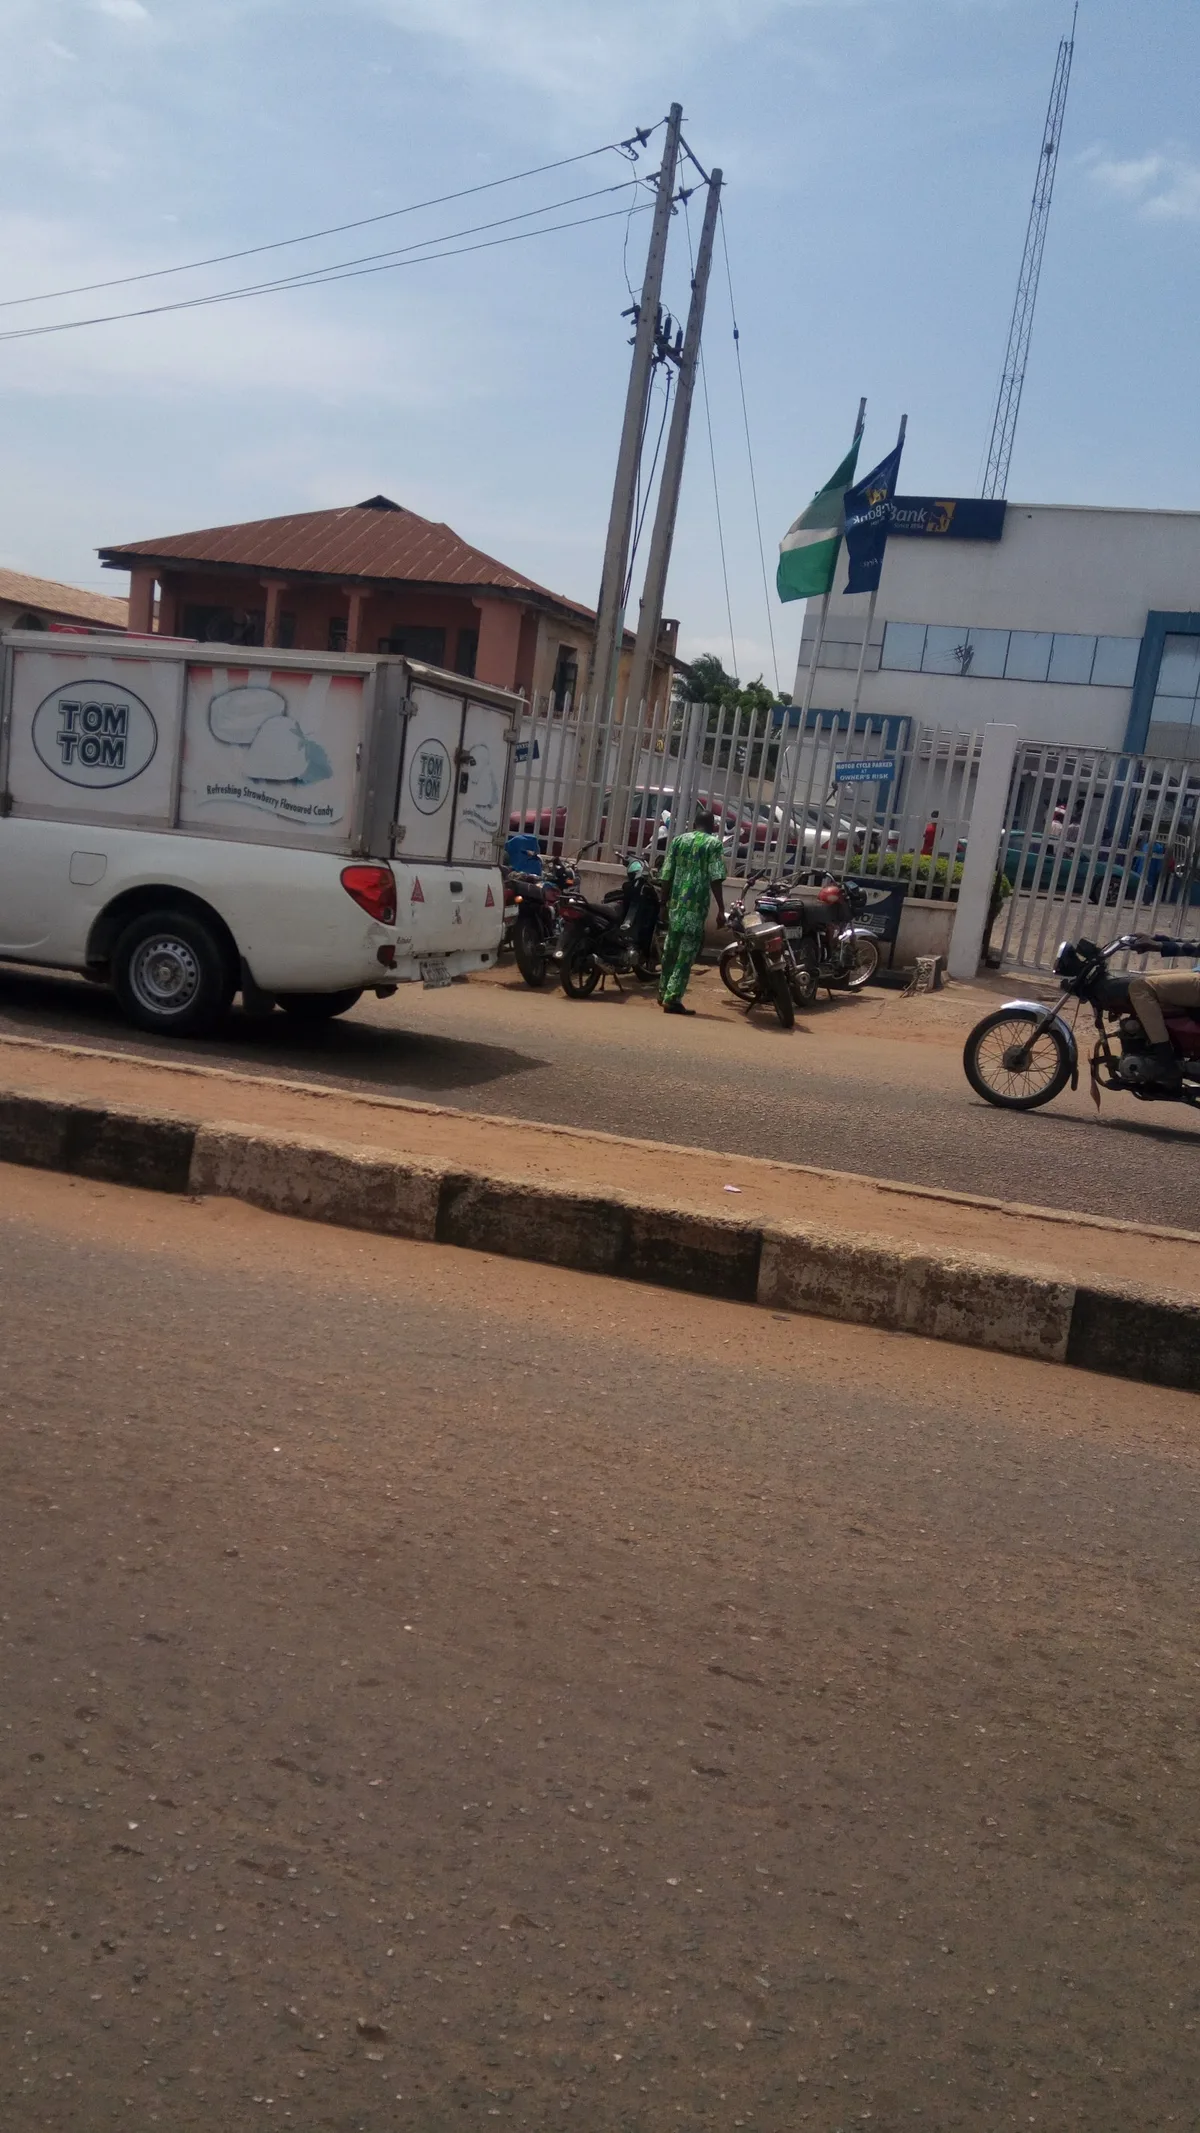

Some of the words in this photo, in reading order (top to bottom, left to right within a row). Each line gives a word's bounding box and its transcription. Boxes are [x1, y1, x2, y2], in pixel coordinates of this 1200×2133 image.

[59, 700, 129, 737] TOM
[57, 731, 127, 769] TOM
[420, 752, 444, 777] TOM
[207, 784, 242, 798] Refreshing
[243, 786, 279, 808] Strawberry
[280, 798, 312, 815] Flavoured
[313, 804, 334, 818] Candy
[418, 775, 441, 801] TOM
